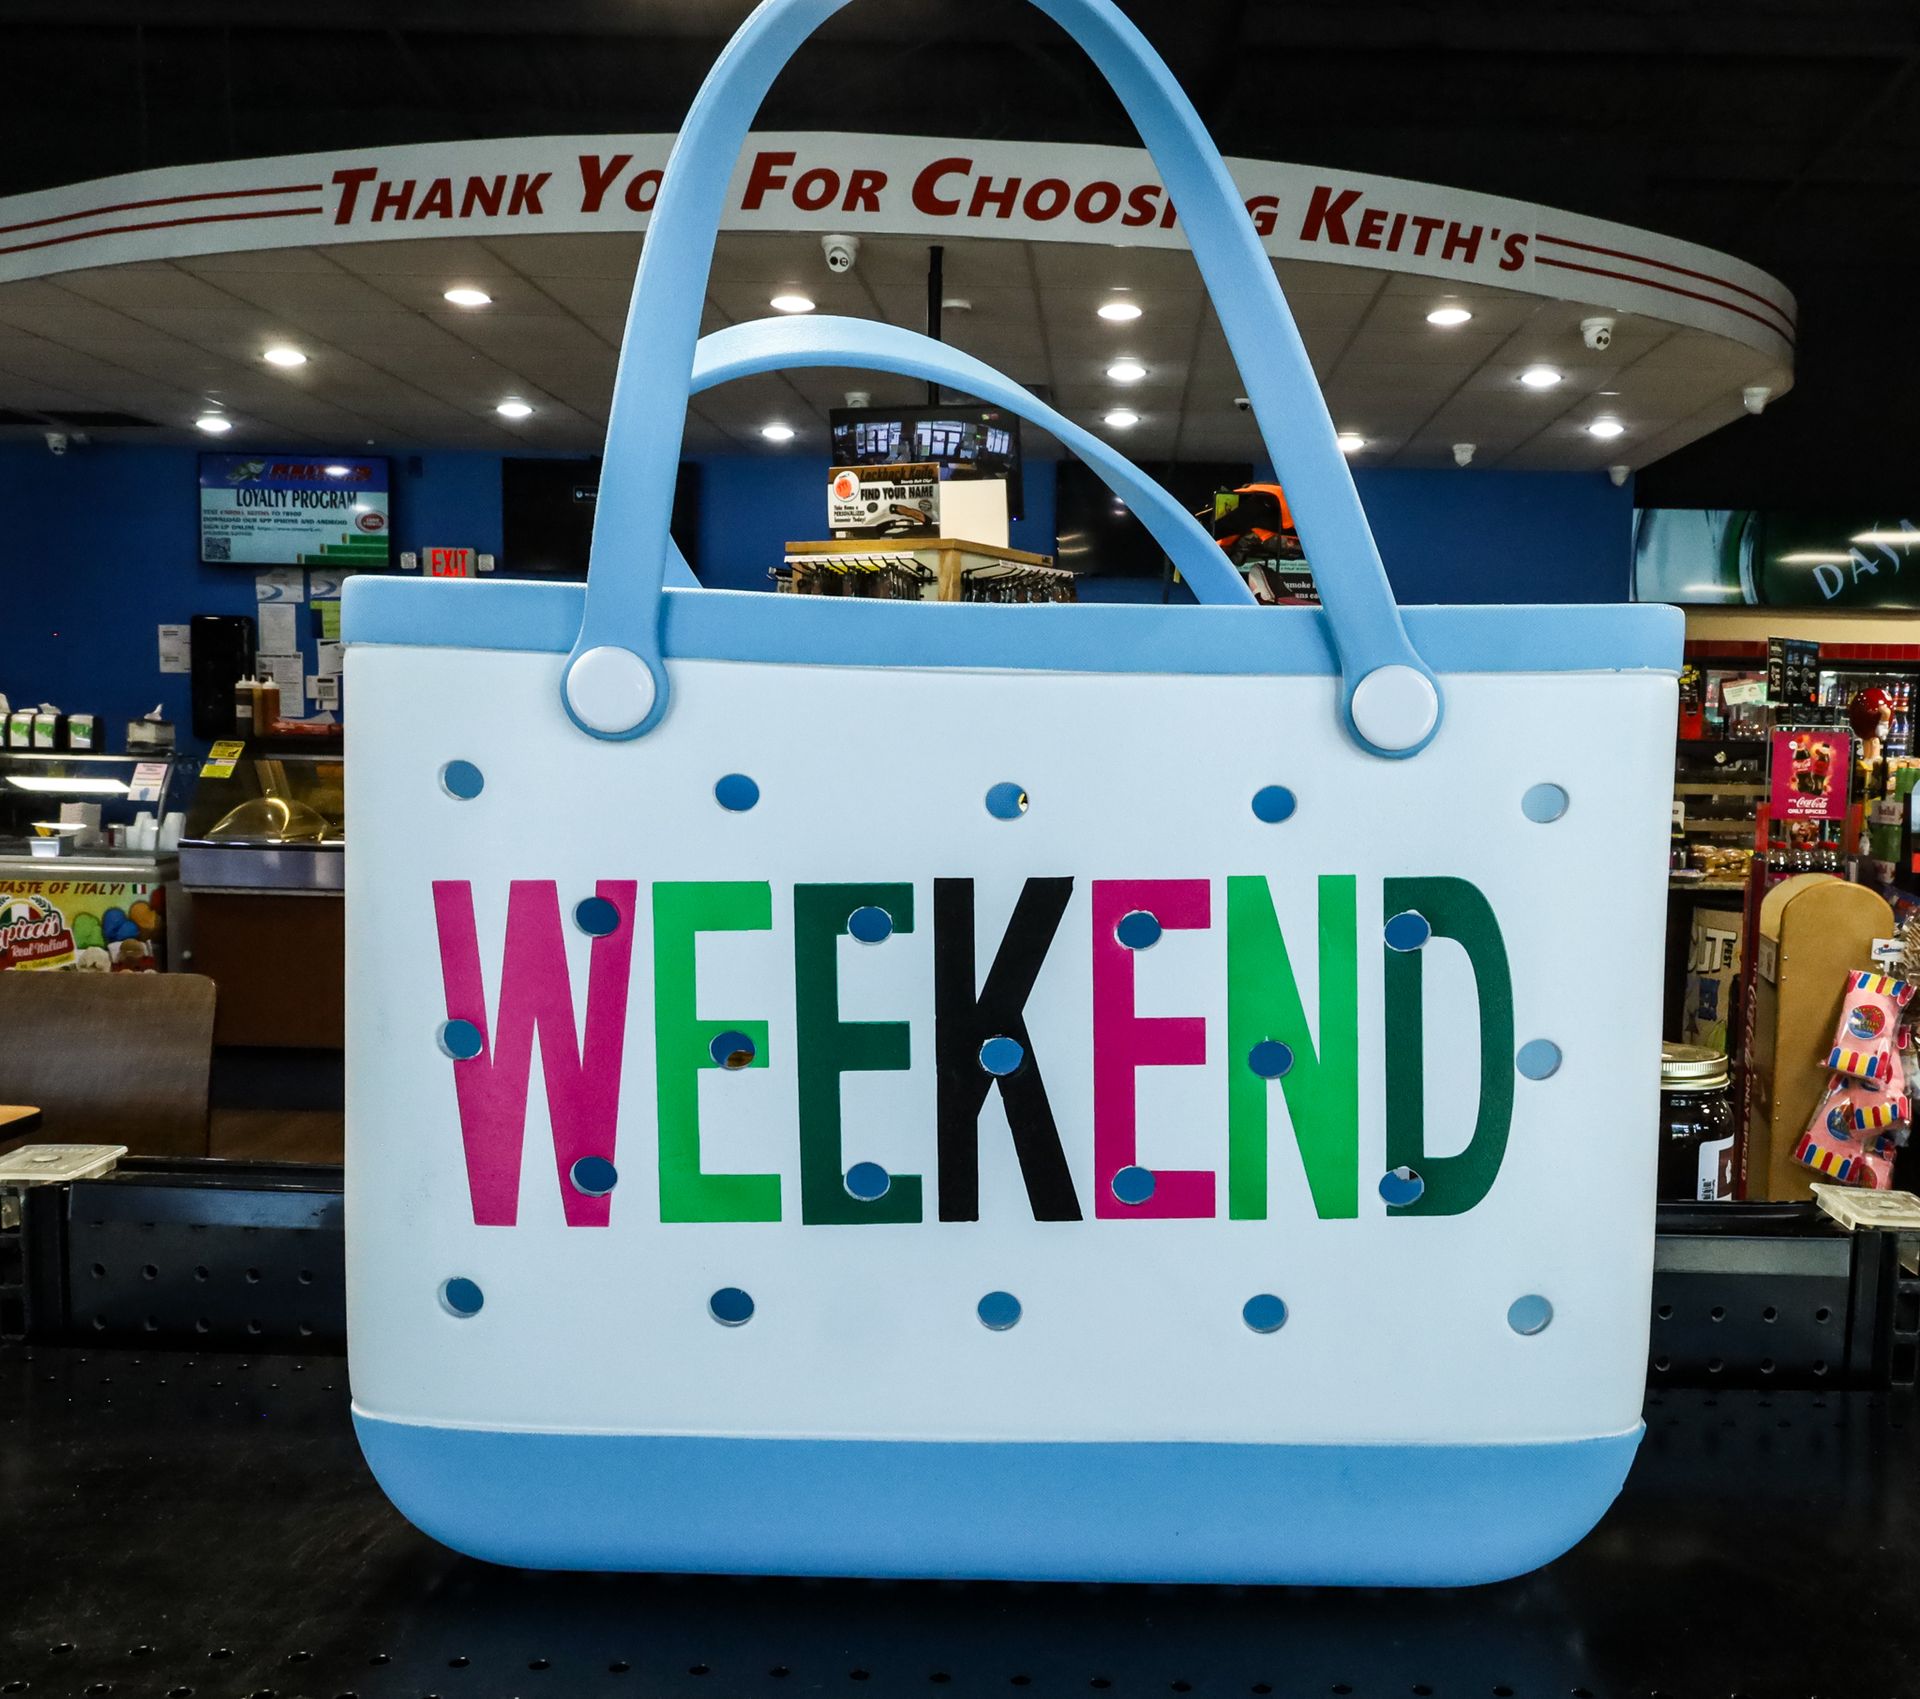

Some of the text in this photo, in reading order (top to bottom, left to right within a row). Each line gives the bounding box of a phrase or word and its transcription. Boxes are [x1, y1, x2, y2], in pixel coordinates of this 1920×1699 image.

[332, 152, 1529, 272] THANK YO FOR CHOOSIG KEITH'S
[236, 488, 358, 509] LOYALTY PROGRAM
[860, 485, 934, 501] FIND YOUR NAME
[431, 549, 469, 577] EXIT
[48, 882, 71, 895] OF
[431, 874, 1515, 1227] WEEKEND
